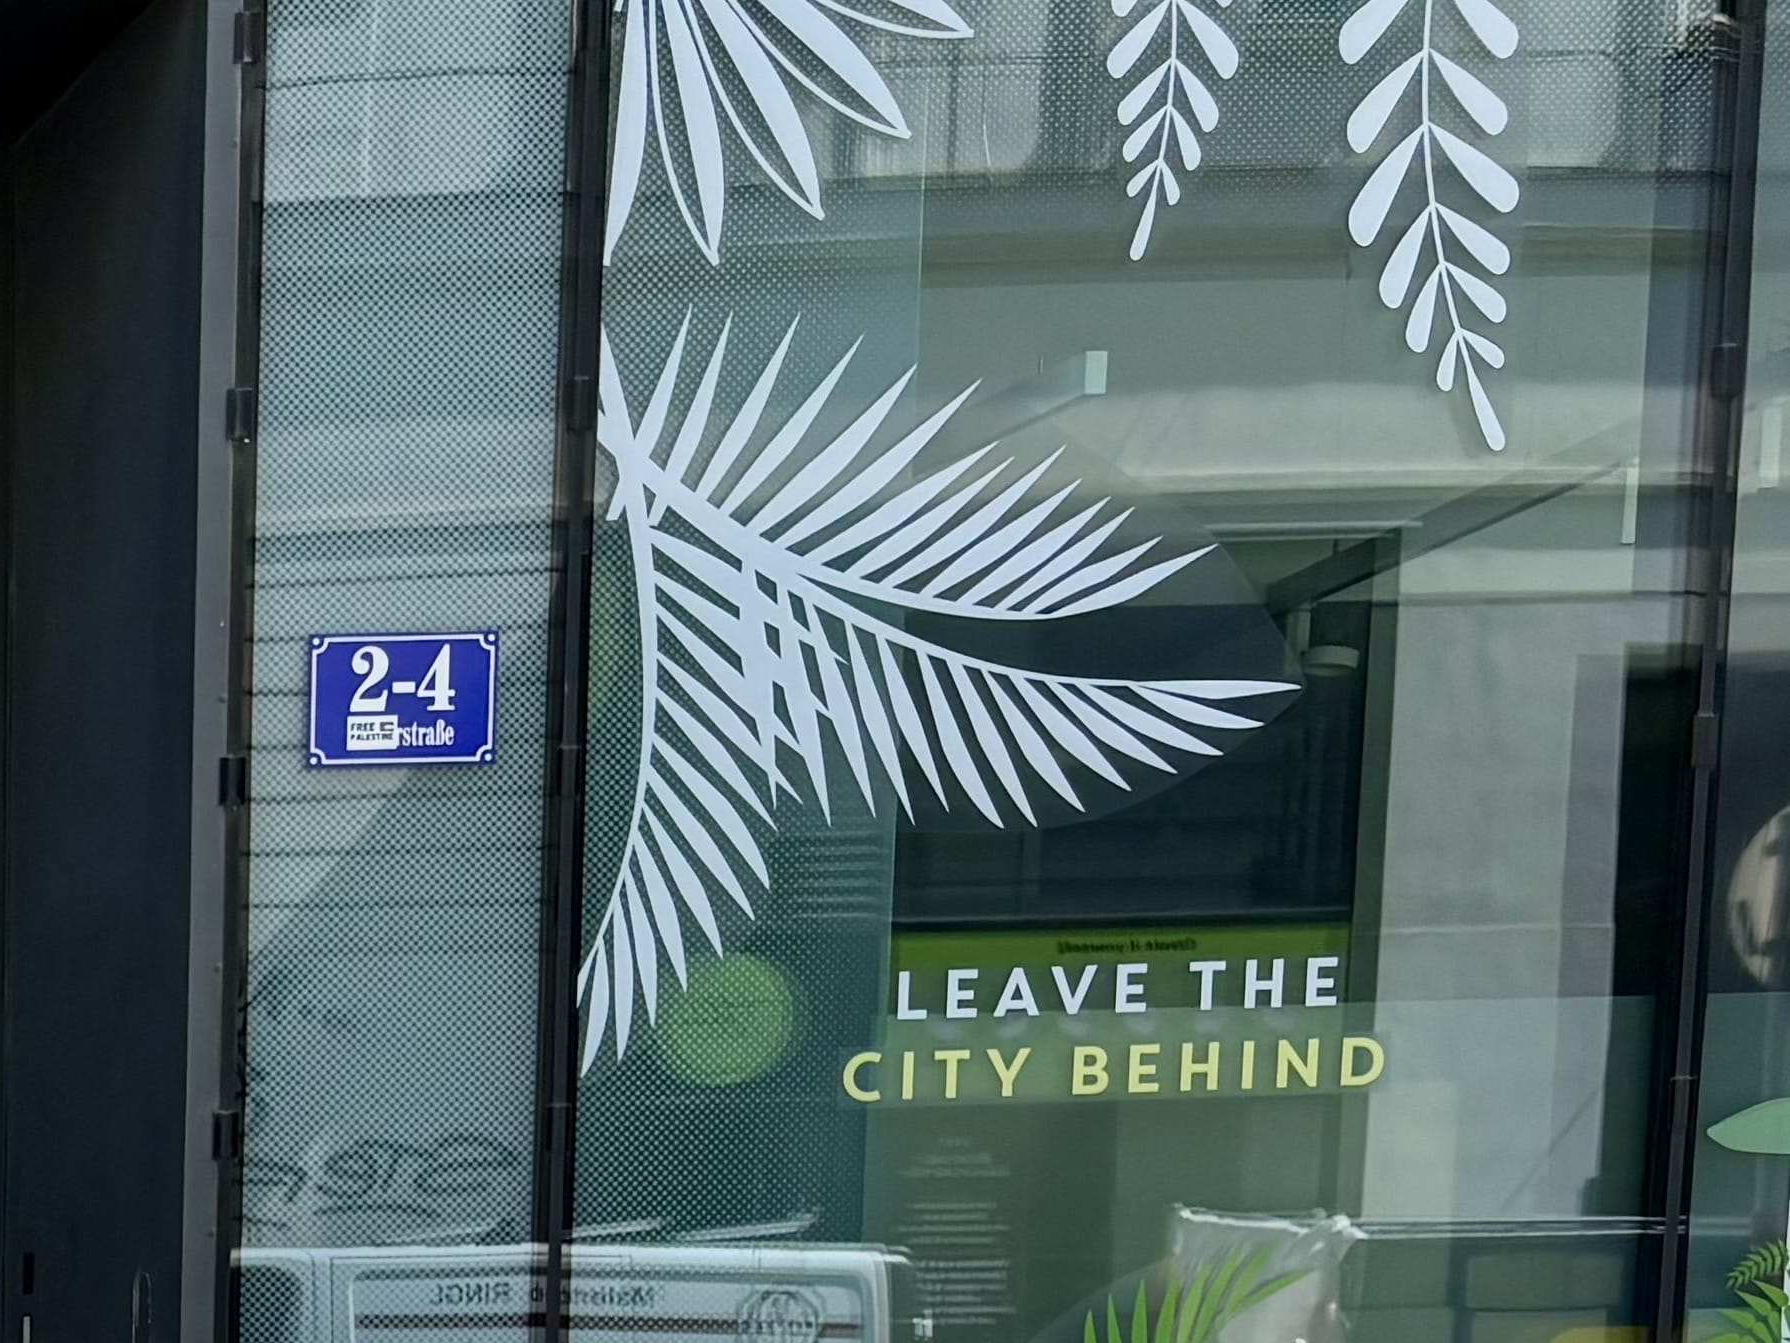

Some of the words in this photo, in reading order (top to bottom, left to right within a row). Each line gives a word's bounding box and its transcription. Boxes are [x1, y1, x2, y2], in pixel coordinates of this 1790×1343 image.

[349, 643, 456, 712] 2-4
[350, 721, 375, 732] FREE
[350, 732, 394, 741] PALESTINE
[896, 961, 1149, 1021] LEAVE
[1188, 955, 1340, 1012] THE
[842, 1046, 1033, 1103] CITY
[1071, 1035, 1386, 1097] BEHIND
